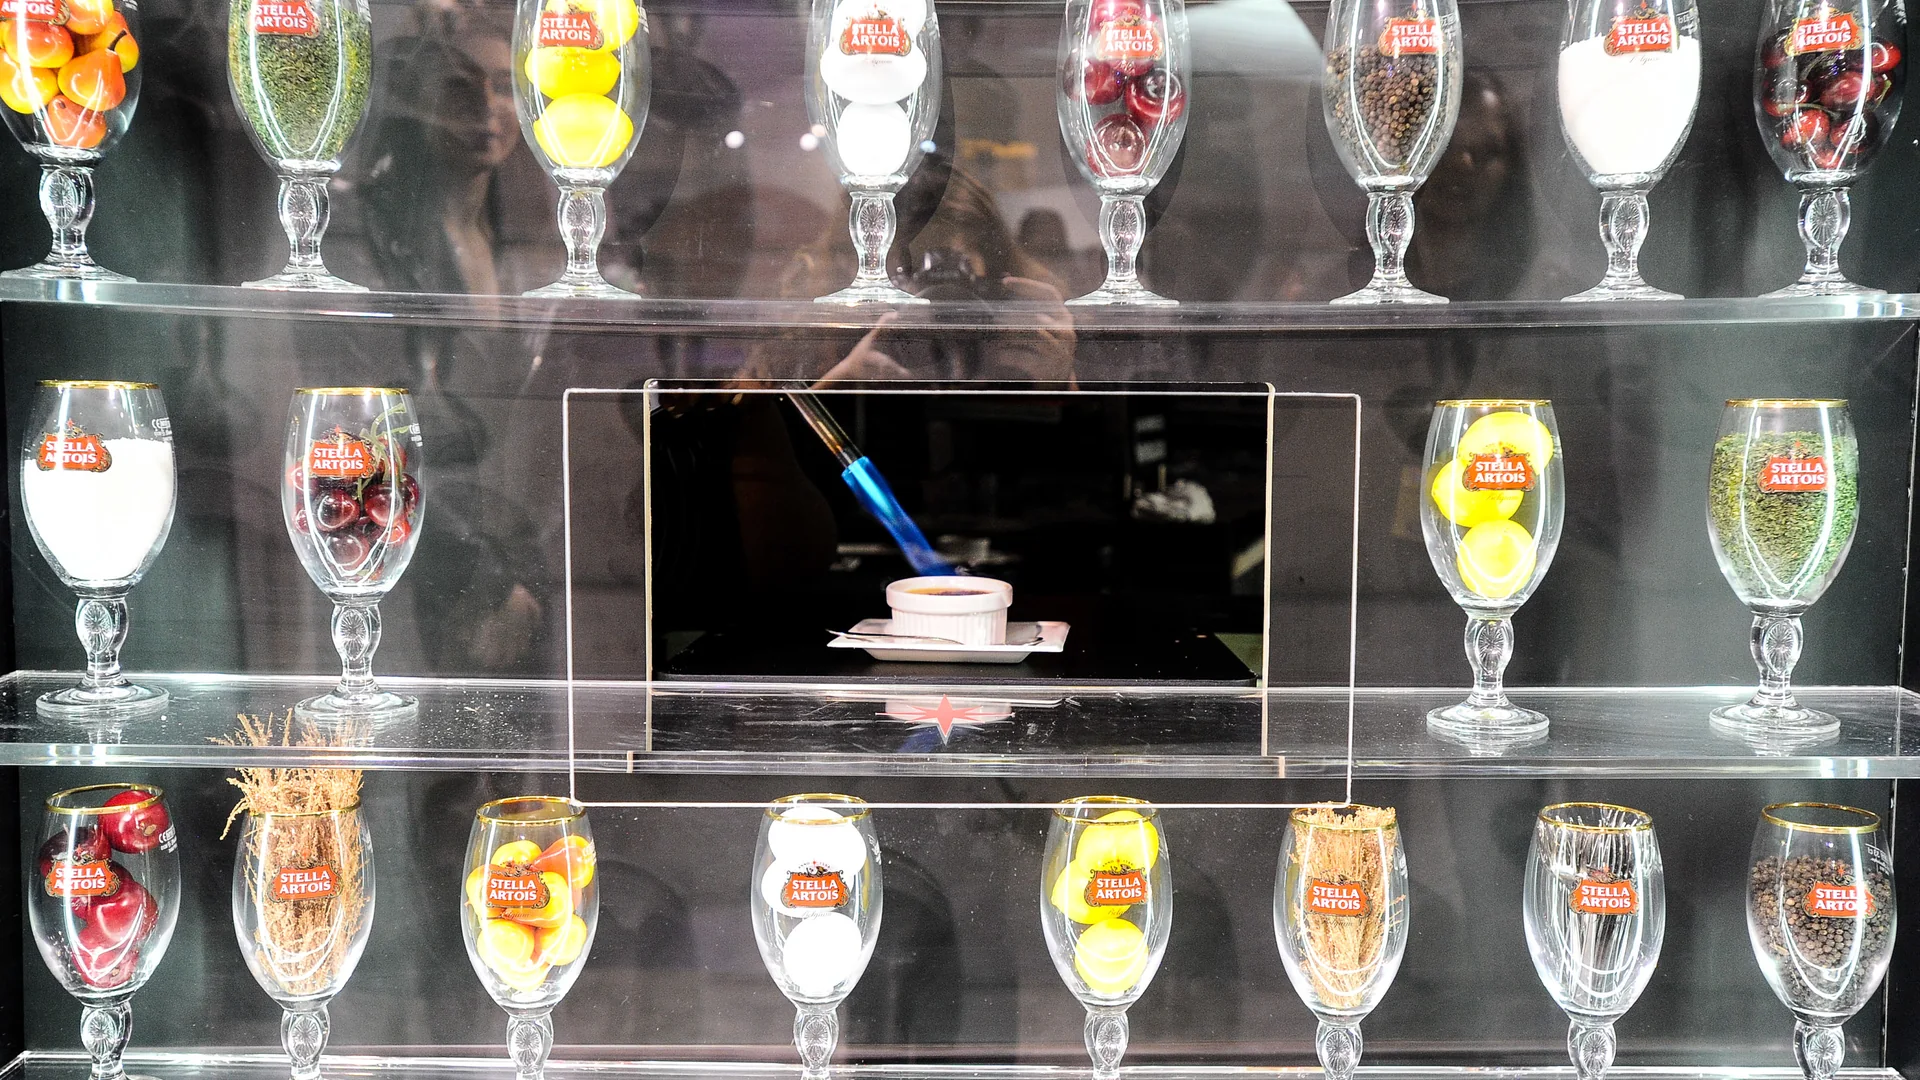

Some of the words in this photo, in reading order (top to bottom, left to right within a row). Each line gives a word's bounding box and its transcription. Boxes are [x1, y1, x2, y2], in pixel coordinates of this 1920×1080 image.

[1, 1, 55, 15] AOIS
[255, 5, 306, 17] STELLA
[255, 16, 307, 29] ARTOIS
[542, 17, 590, 29] STELLA
[1618, 22, 1668, 35] STELLA
[1798, 20, 1850, 35] STELLA
[542, 28, 591, 41] ARTOIS
[851, 23, 899, 35] STELLA
[1392, 25, 1438, 36] STELL
[851, 35, 900, 47] ARTOIS
[1392, 36, 1442, 47] ARTOI
[1617, 34, 1670, 46] ARTOIS
[1796, 32, 1852, 46] ARTOIS
[1105, 40, 1154, 52] ARTOIS
[46, 441, 95, 452] SELLA
[45, 452, 97, 464] ATOIS
[314, 448, 362, 459] STELLA
[313, 459, 363, 470] ARTOIS
[1475, 461, 1525, 471] STELLA
[1771, 462, 1824, 473] STELLA
[1474, 472, 1526, 483] ARTOIS
[1771, 474, 1825, 485] ARTOIS
[55, 867, 105, 878] SELLA
[280, 871, 329, 883] STELLA
[54, 878, 106, 889] ATOIS
[280, 882, 331, 894] ARTOIS
[490, 878, 536, 890] STELLA
[792, 880, 838, 890] STELLA
[1096, 877, 1141, 888] STELLA
[489, 890, 537, 901] ARTOIS
[791, 890, 839, 901] ARTOIS
[1095, 887, 1142, 899] ARTOIS
[1312, 886, 1360, 899] STELLA
[1581, 886, 1630, 897] STELLA
[1816, 888, 1866, 900] STELL
[1311, 897, 1361, 910] ARTOIS
[1581, 896, 1631, 907] ARTOIS
[1815, 900, 1868, 912] ARTO
